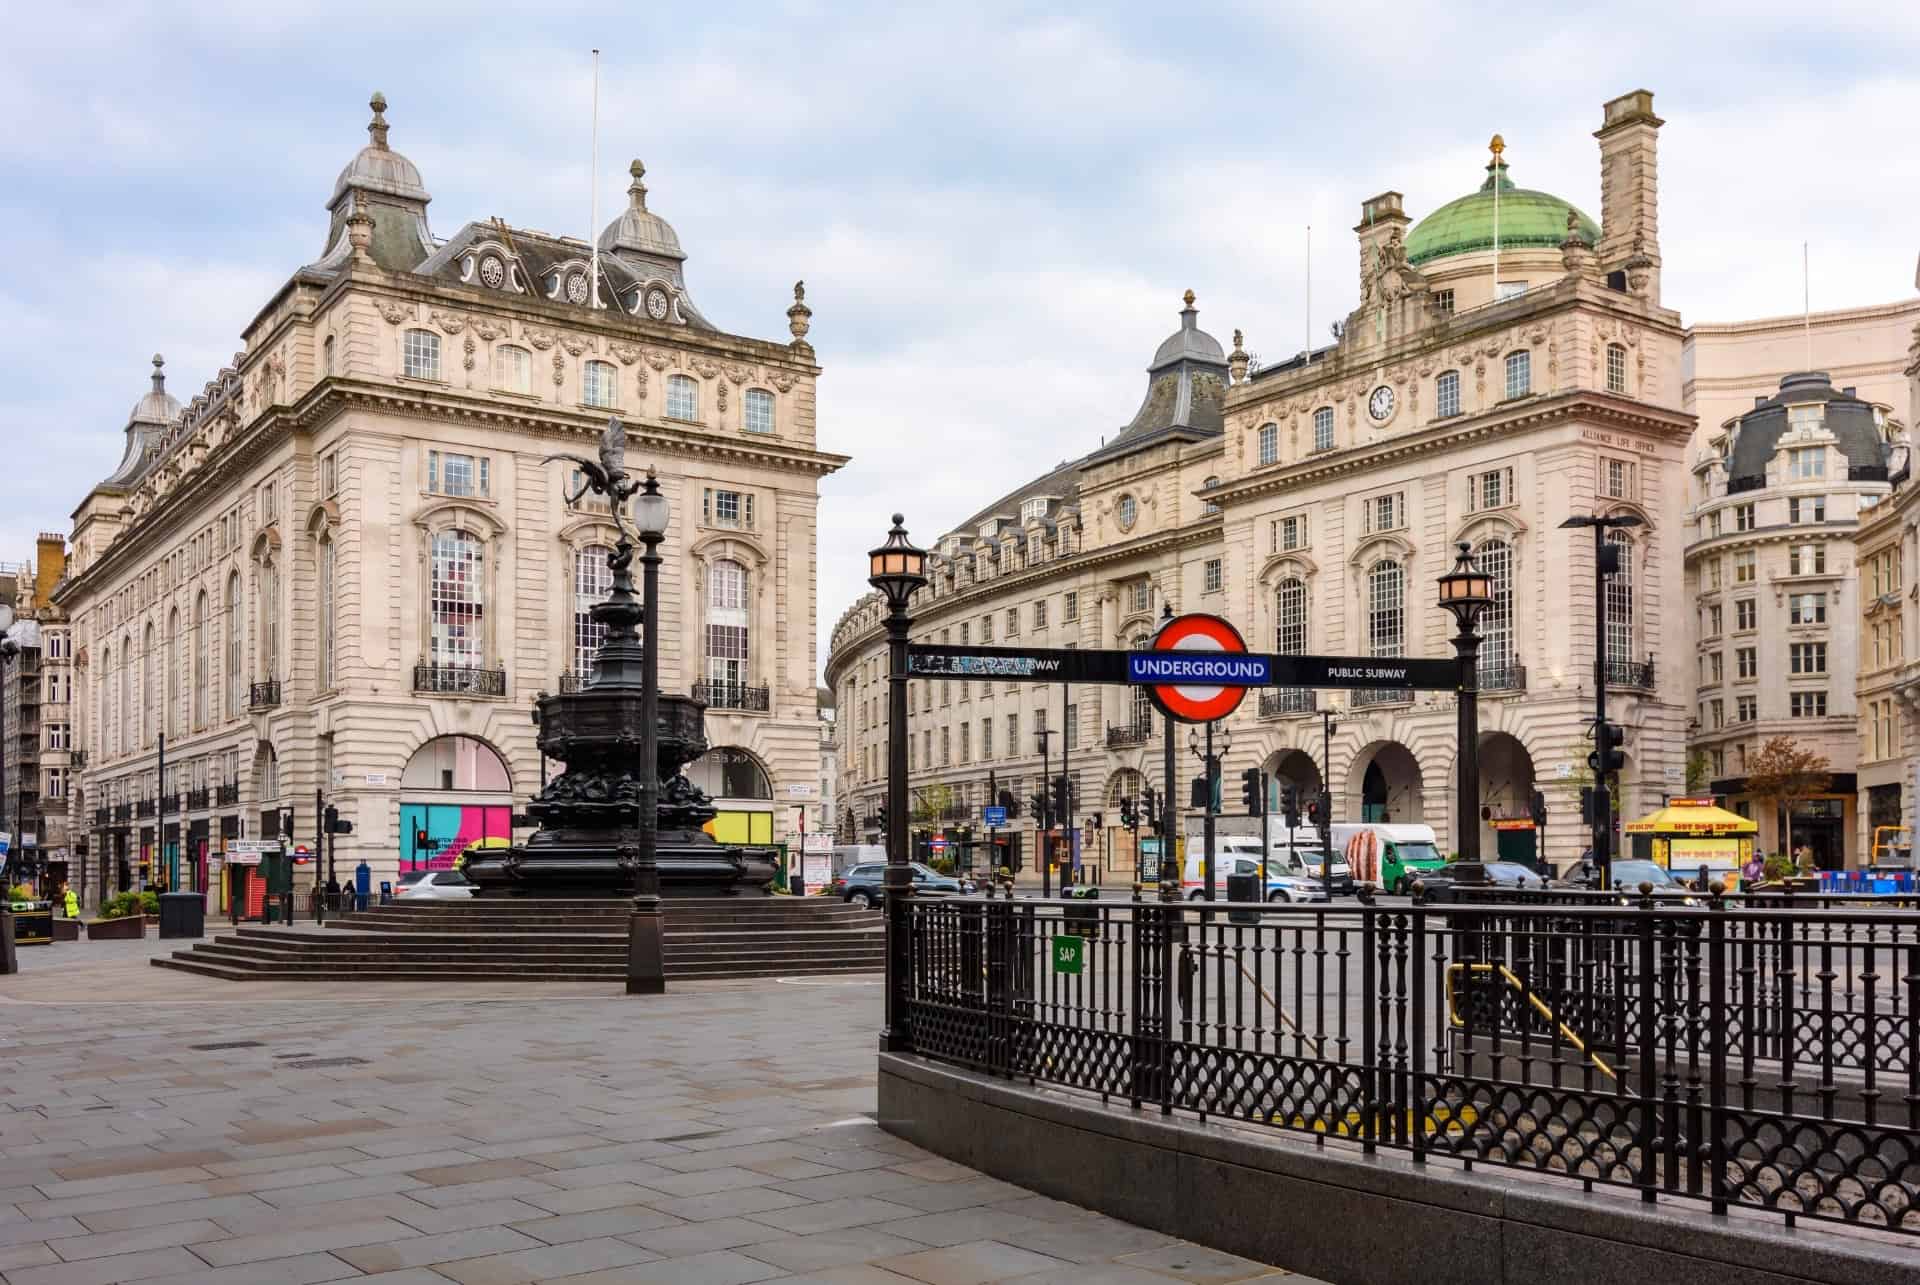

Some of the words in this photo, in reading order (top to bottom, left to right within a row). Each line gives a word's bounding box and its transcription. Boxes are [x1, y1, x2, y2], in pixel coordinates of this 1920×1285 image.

[1582, 427, 1612, 444] ALLIANCE
[1617, 436, 1630, 448] LIFE
[1134, 660, 1265, 677] UNDERGROUND
[1328, 667, 1363, 678] PUBLIC
[1365, 668, 1407, 679] SUBWAY
[1059, 946, 1076, 962] SAP
